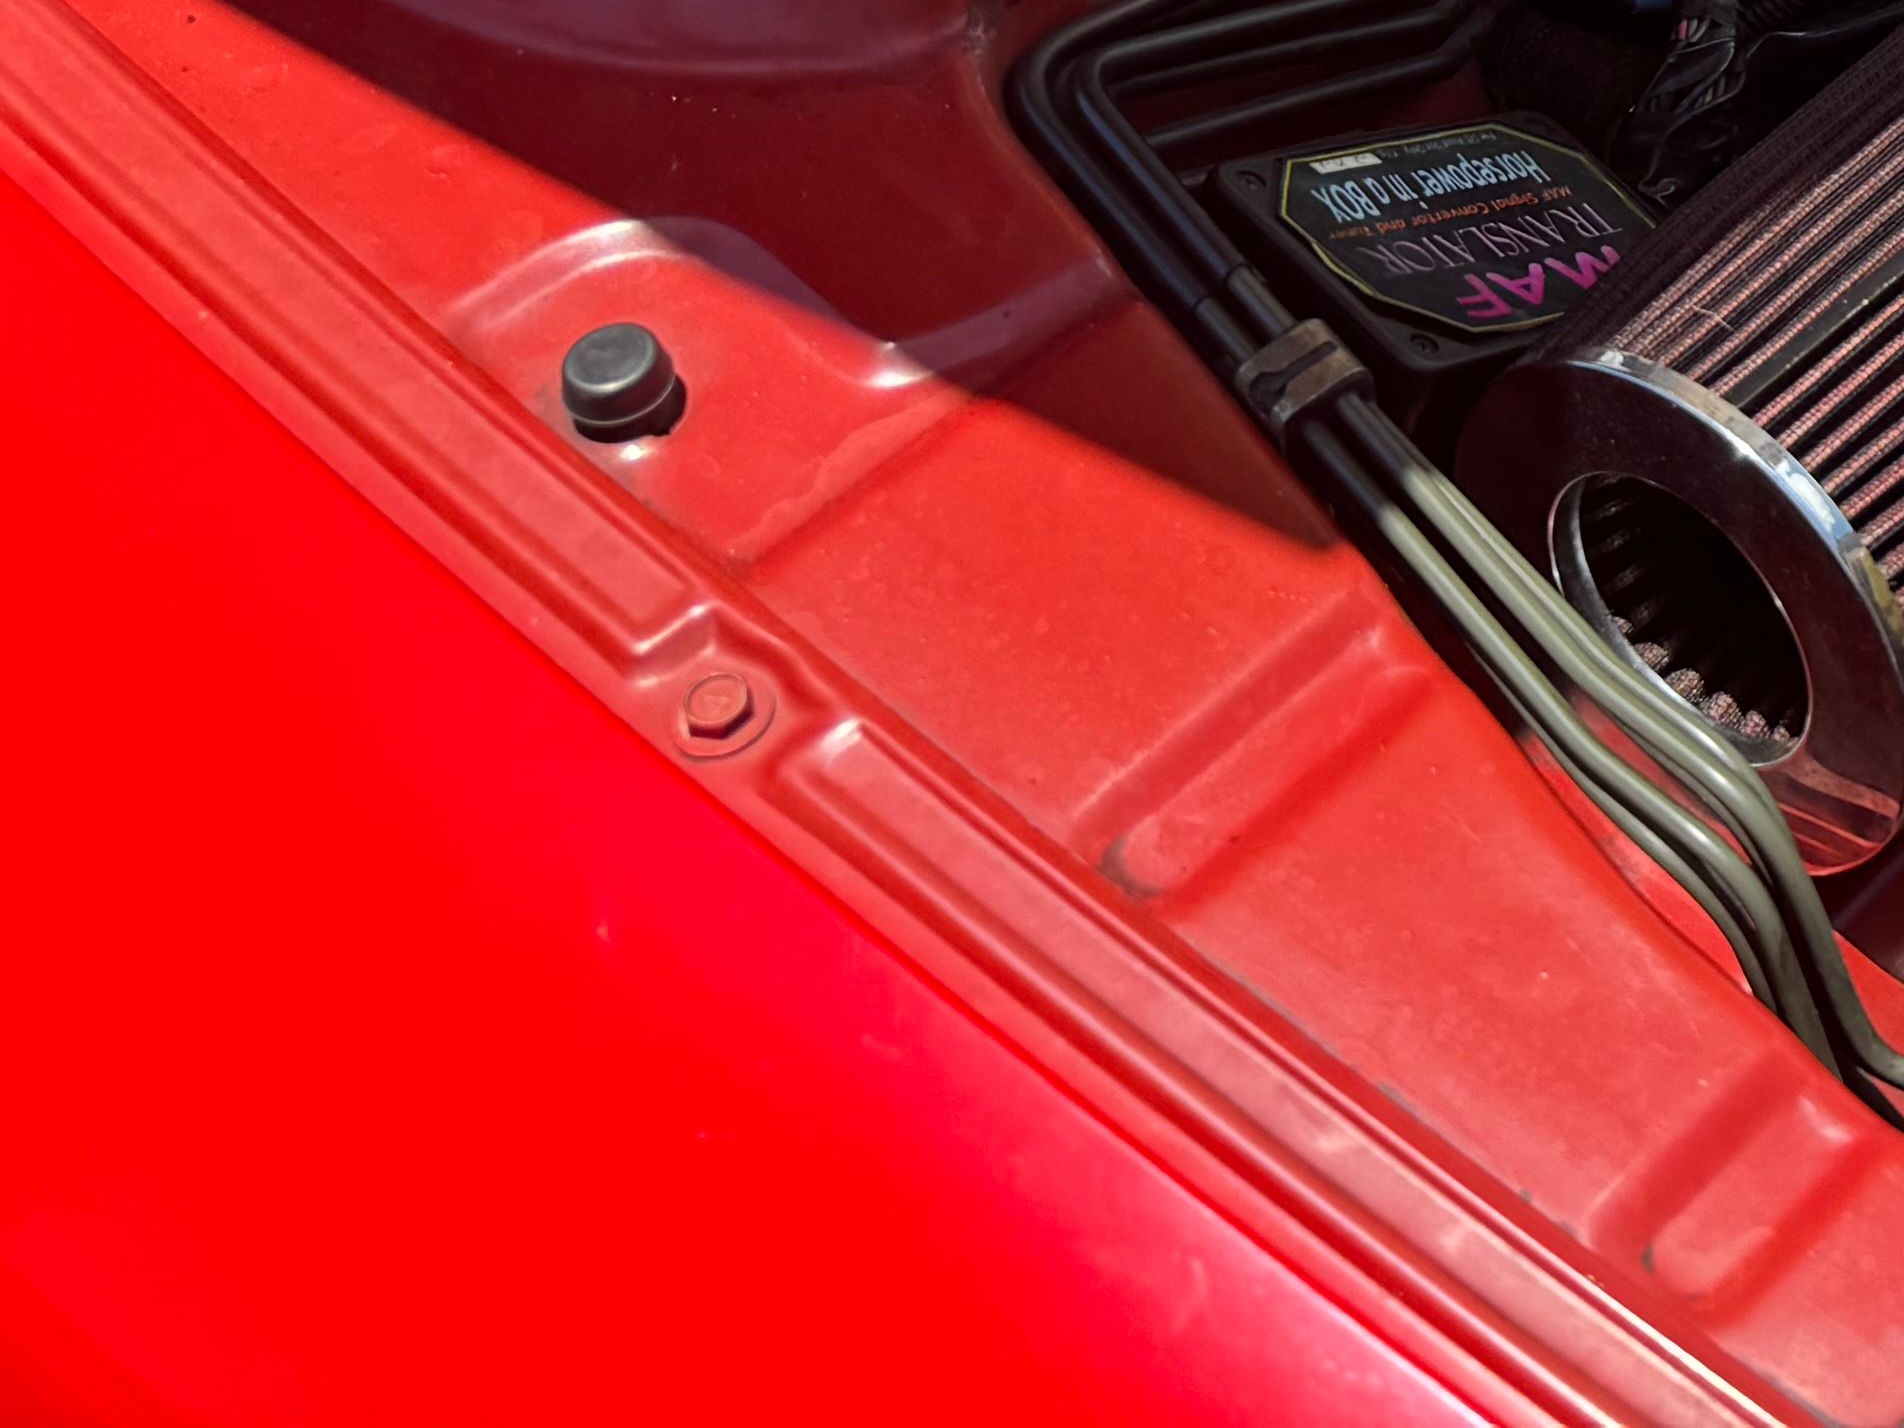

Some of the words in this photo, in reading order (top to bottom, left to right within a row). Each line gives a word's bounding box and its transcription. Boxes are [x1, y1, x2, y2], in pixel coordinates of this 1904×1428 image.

[1310, 178, 1380, 224] BOX
[1420, 151, 1551, 199] Horsepower
[1356, 203, 1622, 275] TRANSLATOR
[1456, 245, 1621, 320] MAF
